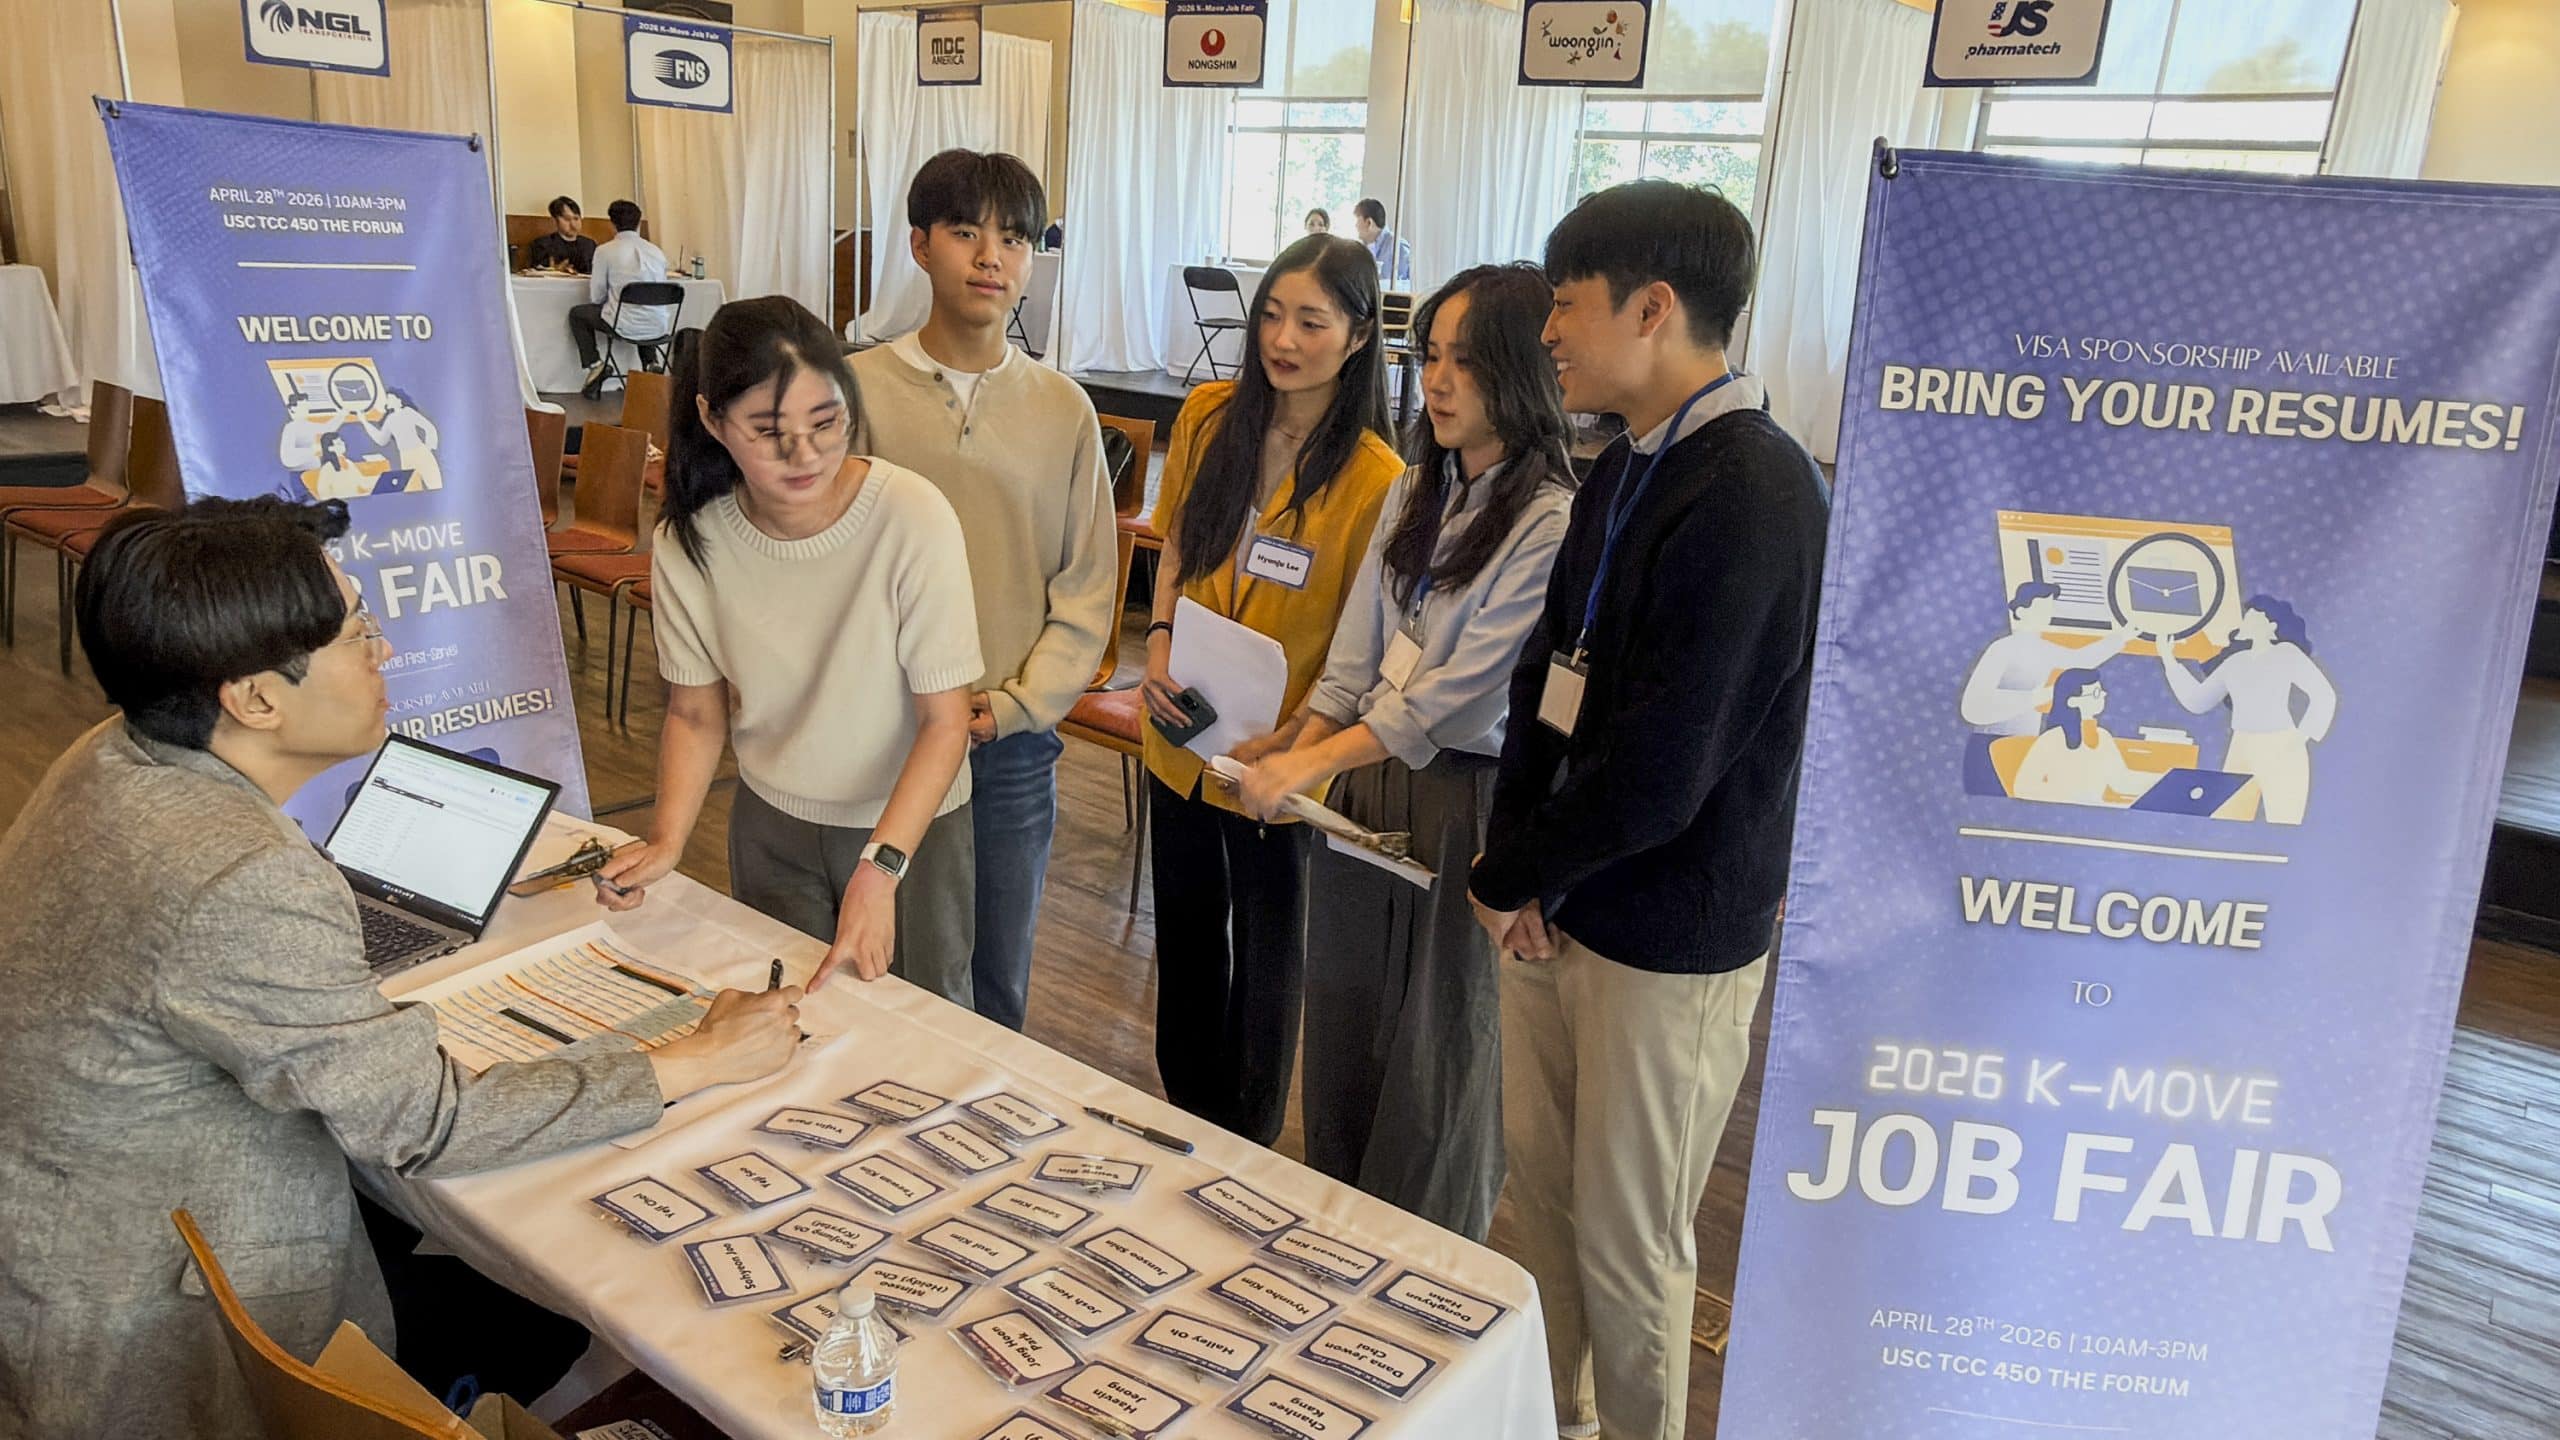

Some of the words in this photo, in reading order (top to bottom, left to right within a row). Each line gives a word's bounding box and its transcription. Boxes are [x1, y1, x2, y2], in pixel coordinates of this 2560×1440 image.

[297, 7, 371, 36] NGL
[1964, 42, 2061, 60] pharmatech
[674, 58, 707, 83] FNS
[1188, 59, 1237, 70] NONGSHIM
[209, 187, 253, 204] APRIL
[288, 192, 323, 206] 2026
[334, 195, 406, 211] 10AM-3PM
[223, 214, 256, 228] USC
[256, 216, 288, 230] TCC
[291, 218, 318, 231] 450
[320, 219, 350, 232] THE
[353, 220, 404, 234] FORUM
[237, 315, 393, 342] WELCOME
[395, 315, 432, 340] TO
[2015, 333, 2073, 360] VISA
[2079, 338, 2262, 371] SPONSORSHIP
[2267, 350, 2399, 380] AVAILABLE
[1879, 364, 2045, 420] BRING
[2060, 377, 2212, 432] YOUR
[2226, 389, 2526, 452] RESUMES!
[351, 522, 464, 561] K-MOVE
[1286, 562, 1299, 571] Lee
[379, 553, 509, 620] FAIR
[431, 686, 553, 737] RESUMES!
[1959, 876, 2269, 949] WELCOME
[2072, 980, 2112, 1008] TO
[1868, 1045, 2005, 1100] 2026
[2025, 1060, 2281, 1125] K-MOVE
[1786, 1108, 2024, 1216] JOB
[2052, 1132, 2343, 1253] FAIR
[1215, 1188, 1235, 1200] Cho
[654, 1205, 675, 1219] Yeji
[950, 1233, 972, 1245] Kim
[1286, 1238, 1309, 1249] Kim
[971, 1243, 999, 1257] Paul
[874, 1270, 898, 1280] Cho
[1241, 1277, 1264, 1290] Kim
[879, 1281, 926, 1296] Minseo
[815, 1304, 836, 1319] Kim
[1075, 1298, 1102, 1314] Josh
[1406, 1292, 1471, 1322] Donghyun
[1018, 1332, 1042, 1351] Park
[1171, 1329, 1189, 1339] Oh
[1869, 1308, 1938, 1334] APRIL
[1944, 1316, 1995, 1337] 28TH
[2000, 1324, 2062, 1350] 2026
[2083, 1335, 2208, 1361] 10AM-3PM
[1015, 1347, 1040, 1367] Jong
[1370, 1359, 1404, 1378] Dana
[1881, 1346, 1932, 1369] USC
[1937, 1353, 1987, 1377] TCC
[1993, 1362, 2040, 1384] 450
[2048, 1368, 2097, 1390] THE
[2102, 1373, 2189, 1398] FORUM
[1107, 1381, 1146, 1403] Jeong
[1268, 1400, 1326, 1431] Chanhee
[1291, 1398, 1325, 1418] Kang
